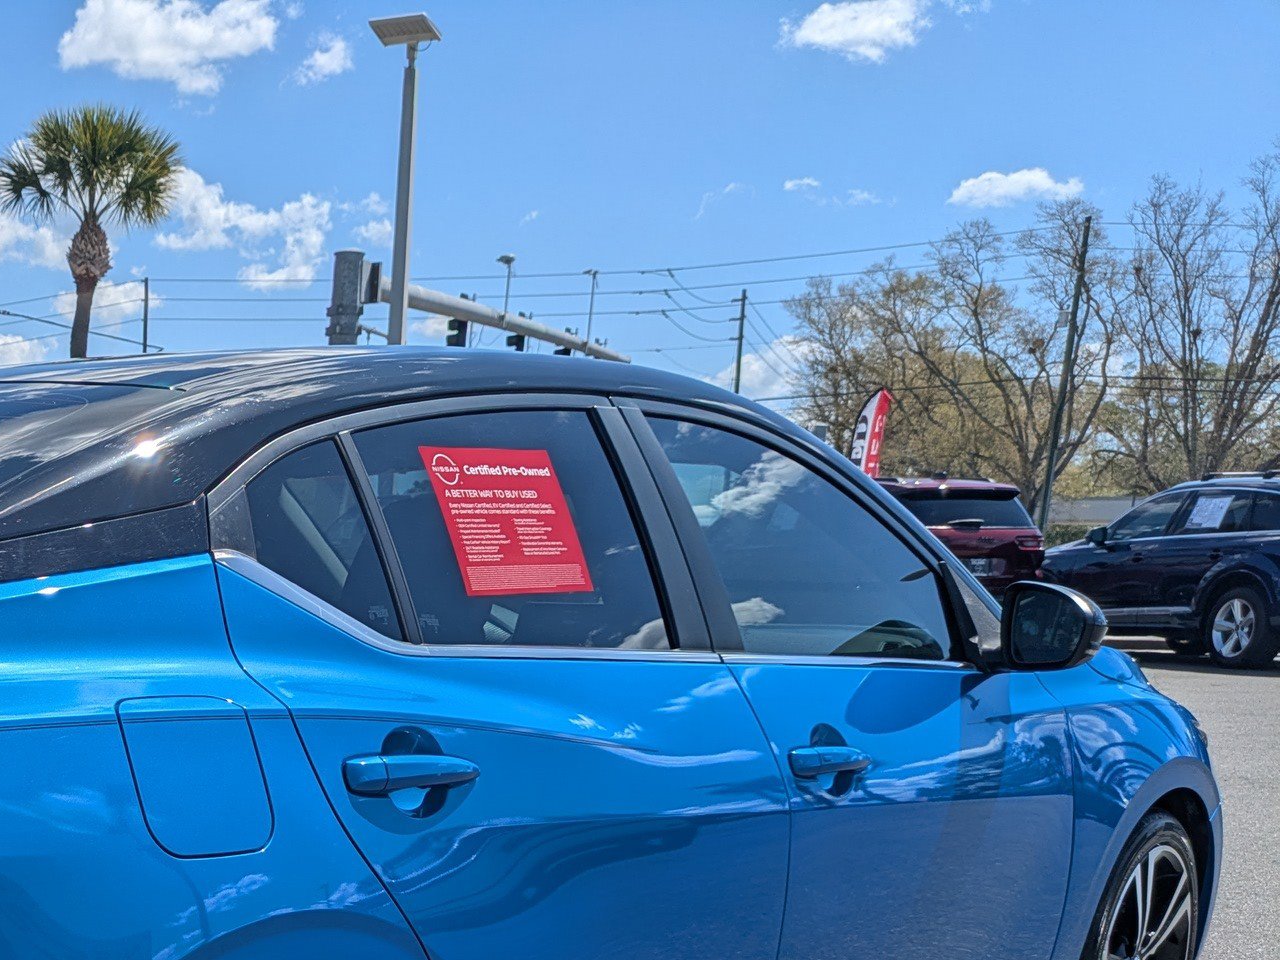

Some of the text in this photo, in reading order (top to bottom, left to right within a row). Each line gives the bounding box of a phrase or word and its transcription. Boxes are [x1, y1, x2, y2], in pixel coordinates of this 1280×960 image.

[431, 465, 460, 473] NISSAN
[463, 464, 551, 477] Certified Pre-Owned
[445, 489, 538, 499] A BETTER WAY TO BUY USED
